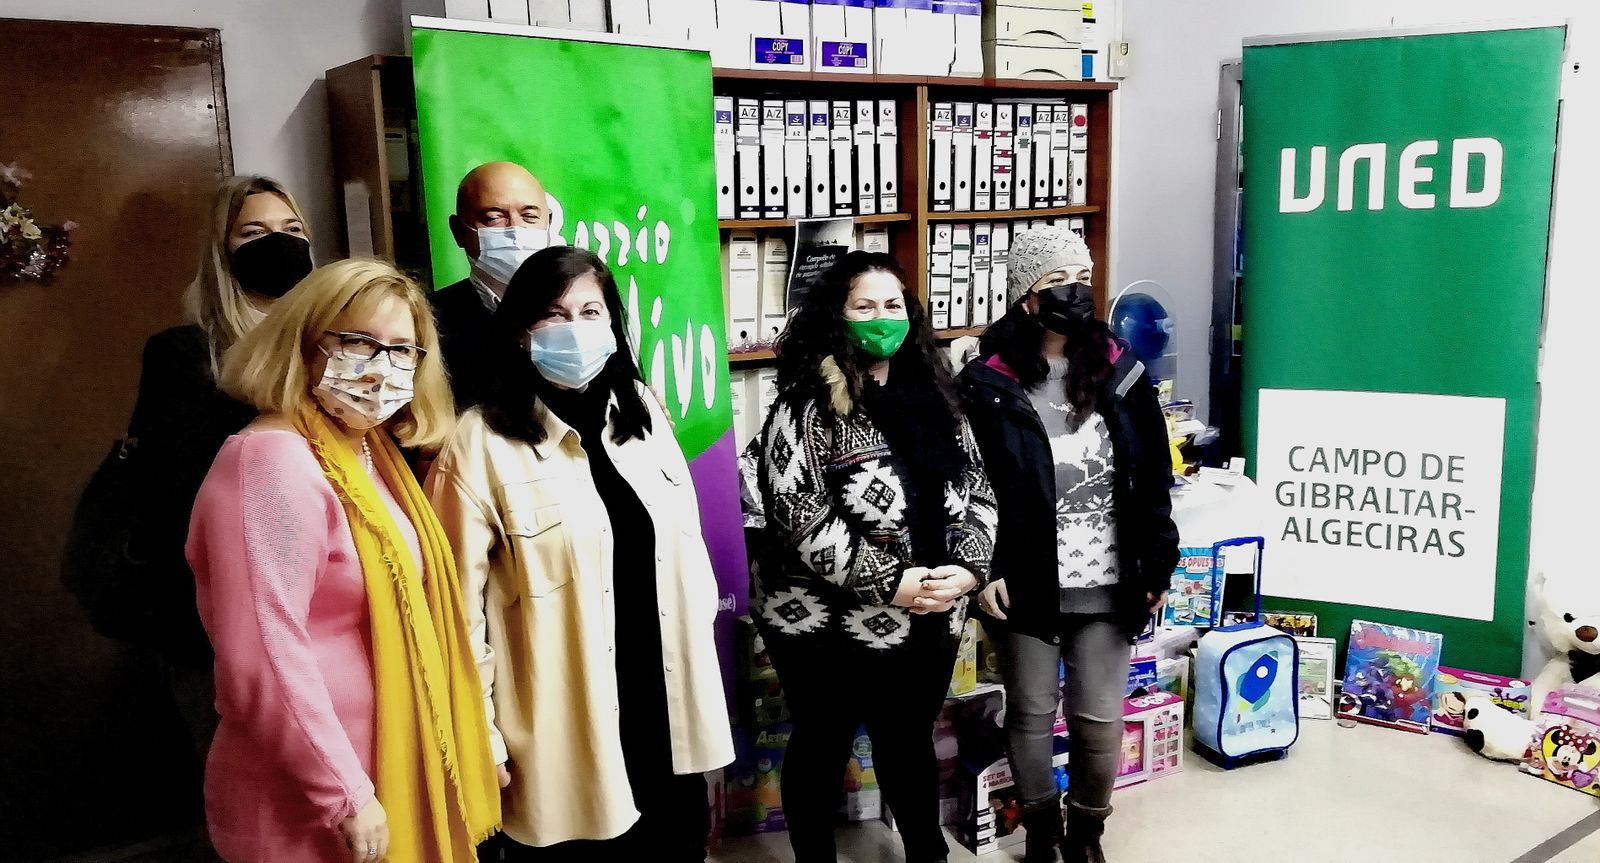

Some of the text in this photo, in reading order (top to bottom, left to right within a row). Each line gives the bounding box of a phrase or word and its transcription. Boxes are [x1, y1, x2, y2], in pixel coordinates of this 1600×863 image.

[772, 41, 789, 51] COPY
[838, 45, 853, 55] COPY
[1279, 137, 1504, 213] UNED
[1288, 445, 1465, 483] CAMPO DE
[1274, 480, 1476, 521] GIBRALTAR-
[1280, 516, 1466, 558] ALGECIRAS
